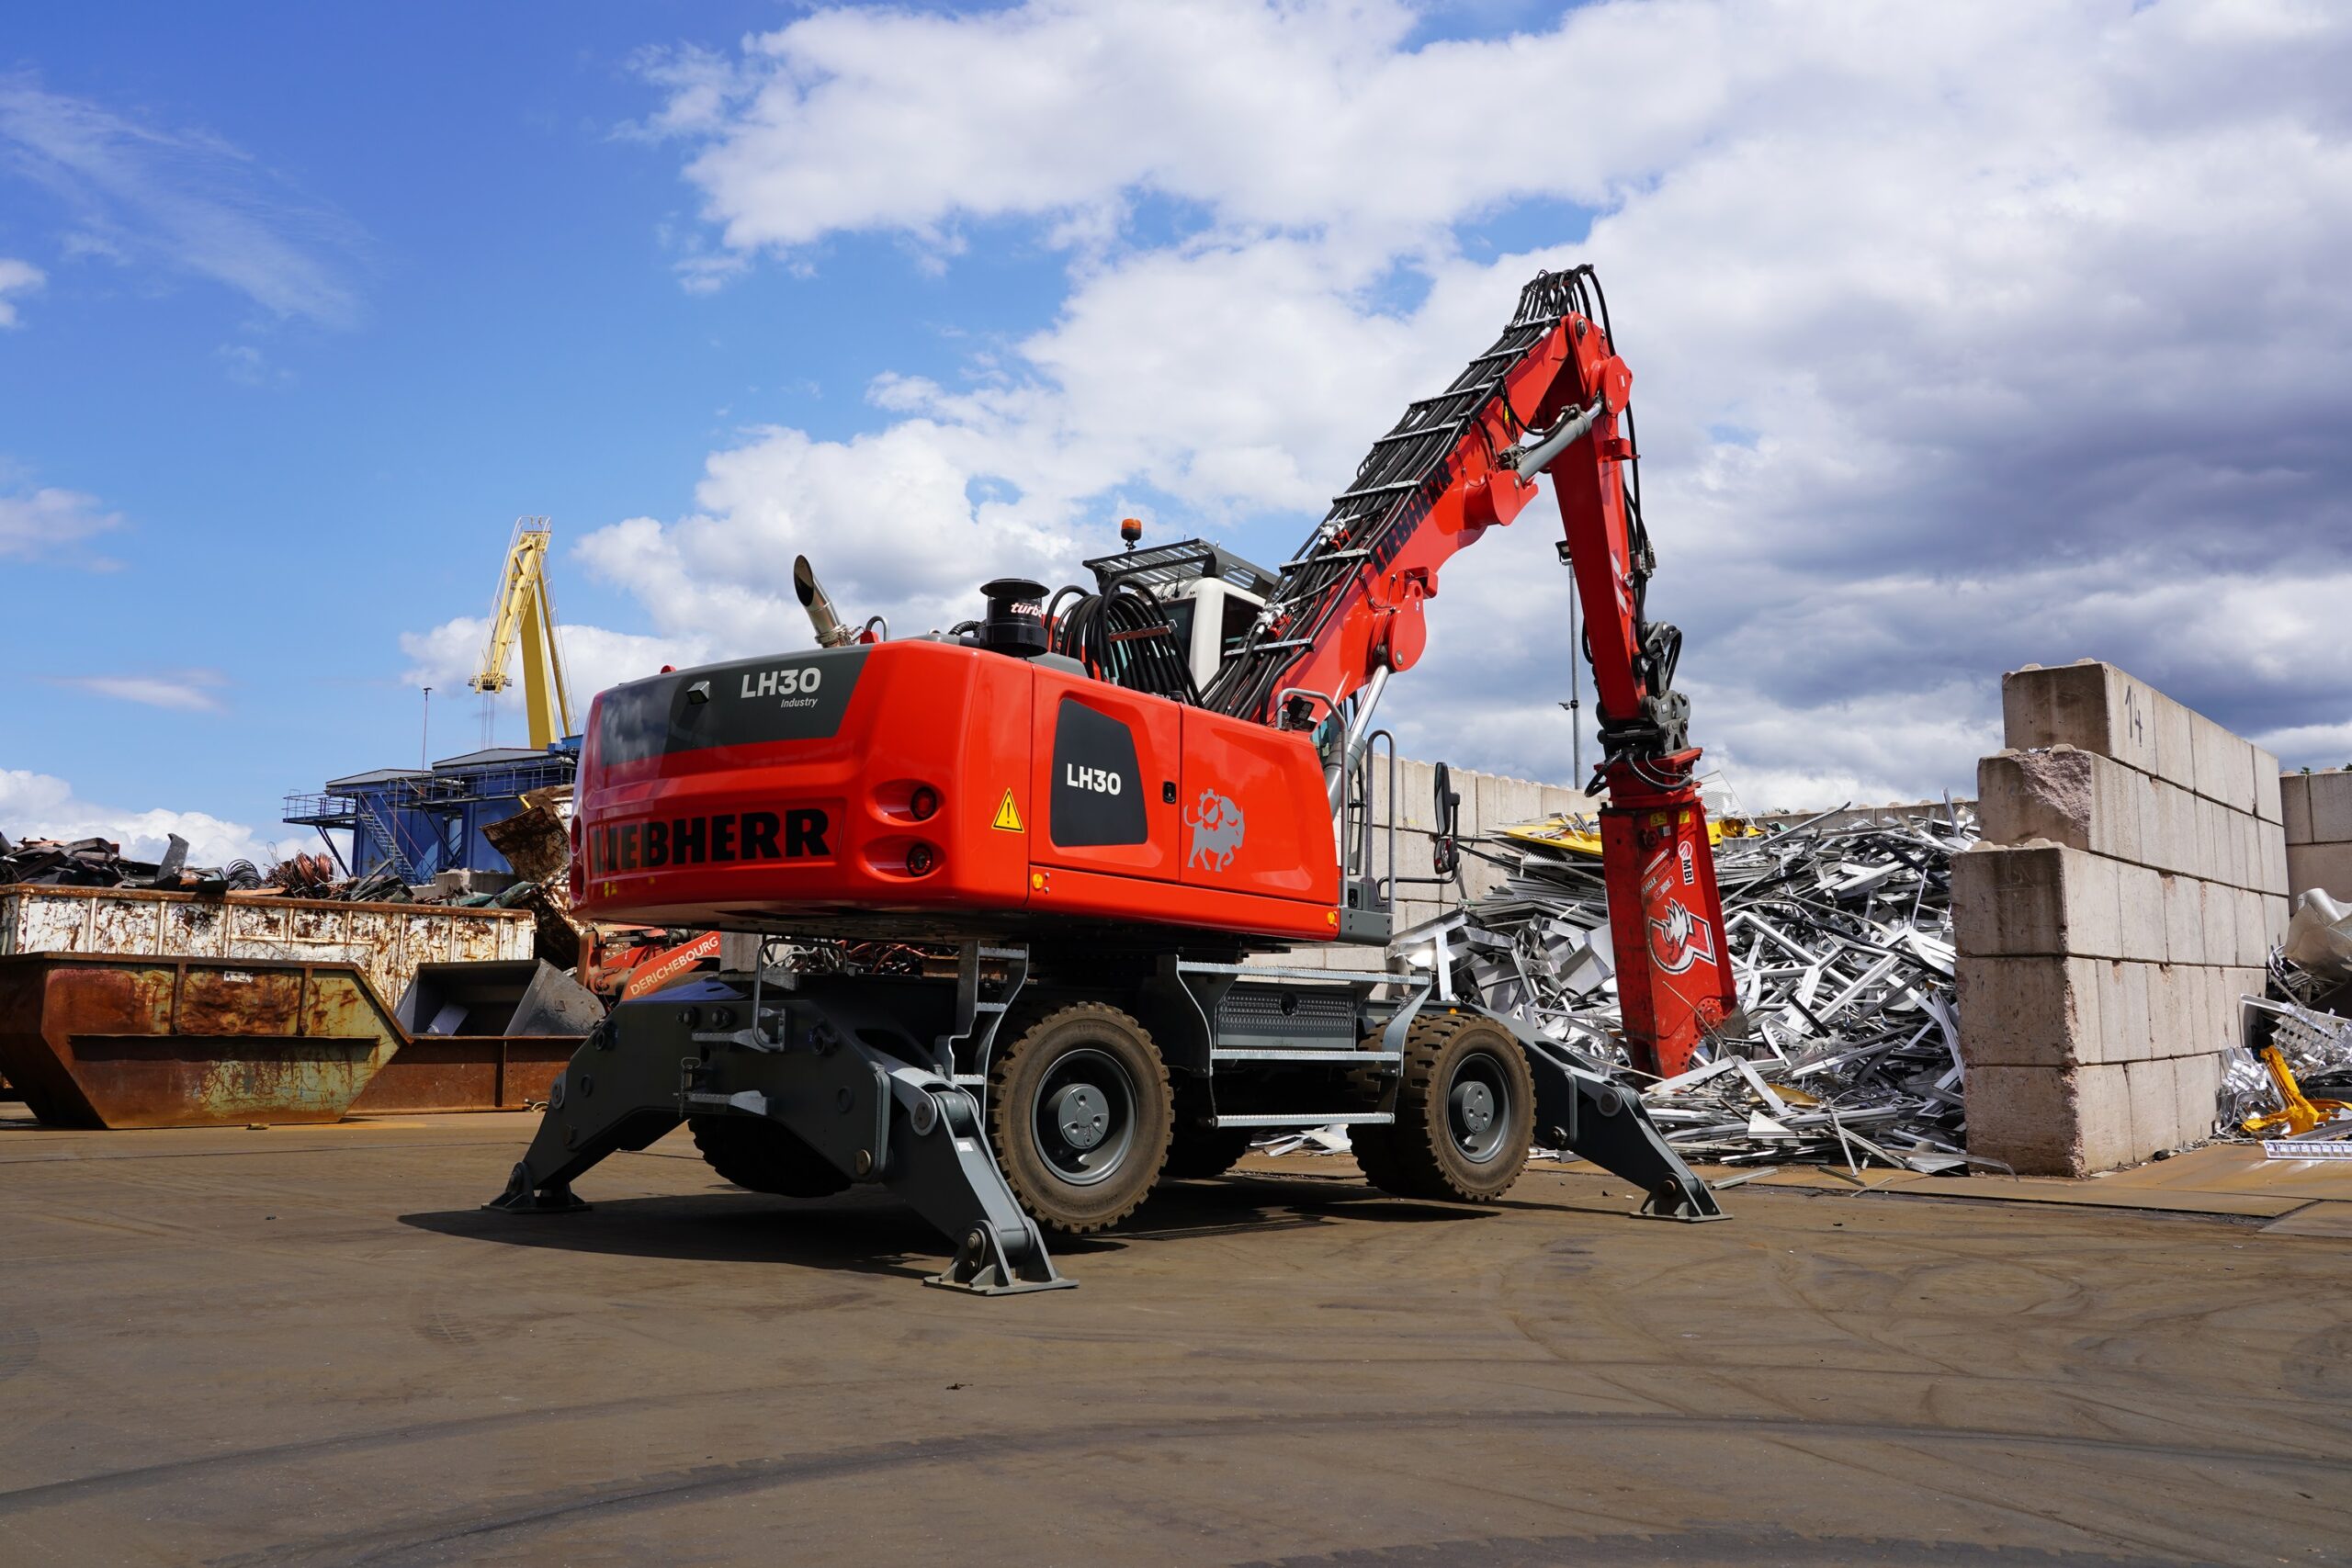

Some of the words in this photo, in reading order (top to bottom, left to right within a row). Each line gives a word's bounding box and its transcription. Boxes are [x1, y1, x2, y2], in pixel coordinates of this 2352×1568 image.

[1369, 458, 1454, 578] LIEBHERR
[741, 667, 821, 699] LH30
[780, 696, 819, 708] Industry
[1067, 763, 1121, 795] LH30
[593, 808, 831, 874] LIEBHERR
[1682, 859, 1693, 884] MBI
[630, 937, 718, 995] DERICHEBOURG
